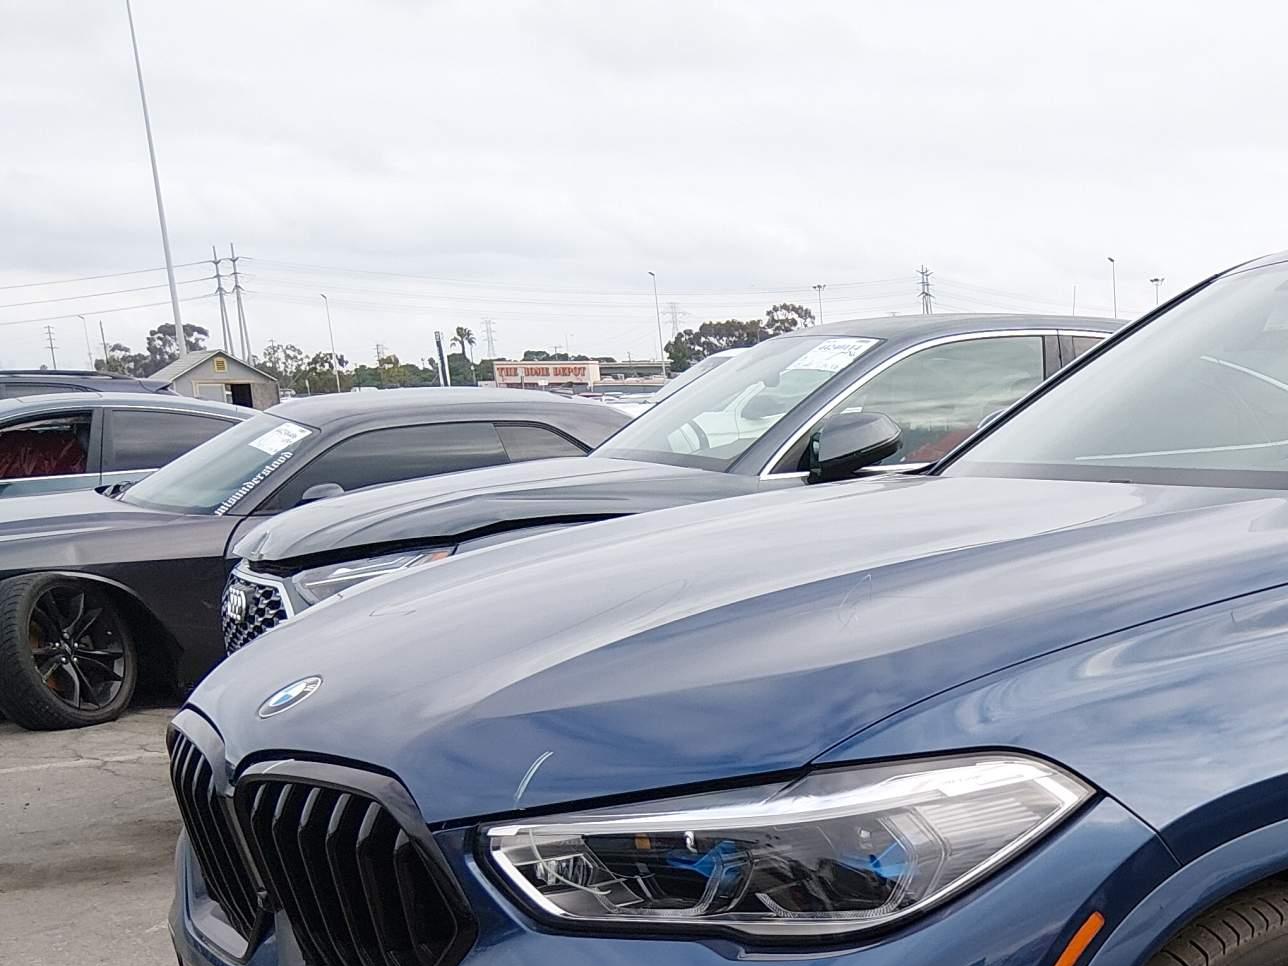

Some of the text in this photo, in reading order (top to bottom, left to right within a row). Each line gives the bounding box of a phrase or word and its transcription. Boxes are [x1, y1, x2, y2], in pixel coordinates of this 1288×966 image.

[497, 367, 518, 377] THE
[553, 367, 586, 377] DEPOT
[214, 451, 294, 516] misunderstood
